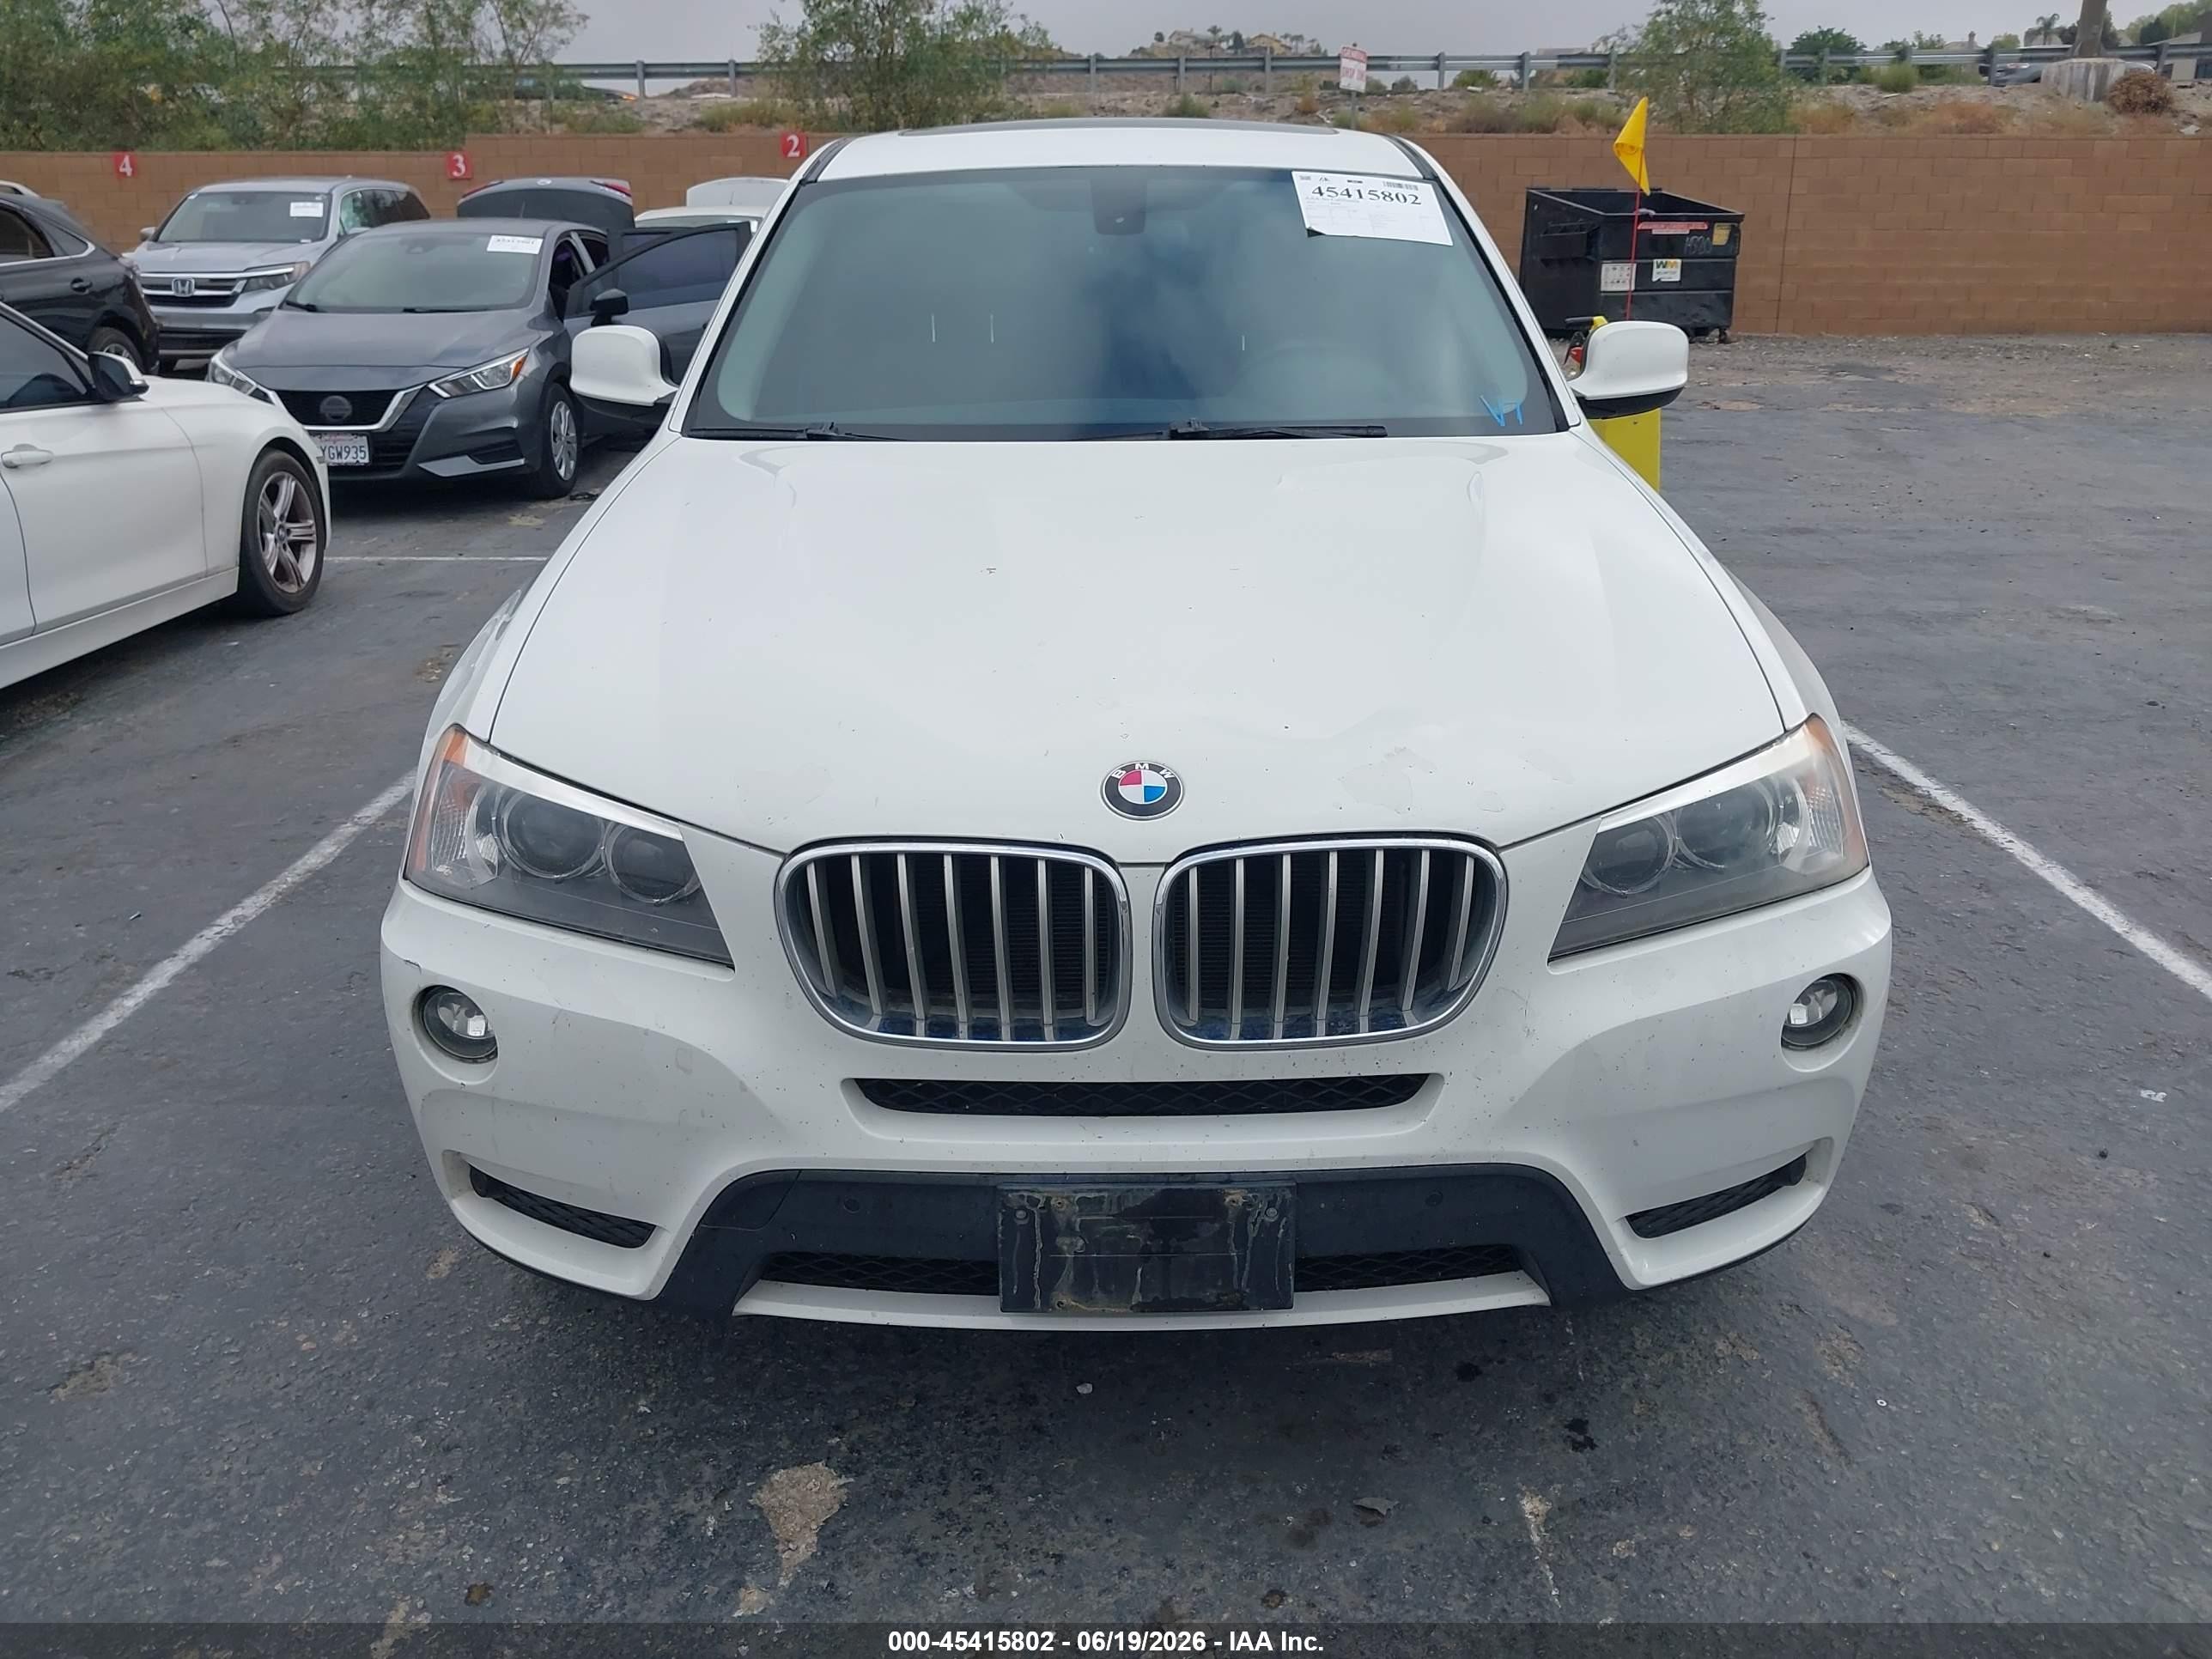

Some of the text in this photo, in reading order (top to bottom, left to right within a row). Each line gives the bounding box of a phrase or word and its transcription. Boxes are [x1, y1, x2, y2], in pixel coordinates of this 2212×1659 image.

[787, 134, 800, 158] 2
[118, 155, 133, 177] 4
[452, 154, 466, 177] 3
[1311, 185, 1422, 205] 45415802
[1656, 260, 1677, 269] WM
[318, 445, 367, 460] YGW935
[1111, 763, 1175, 779] BMW
